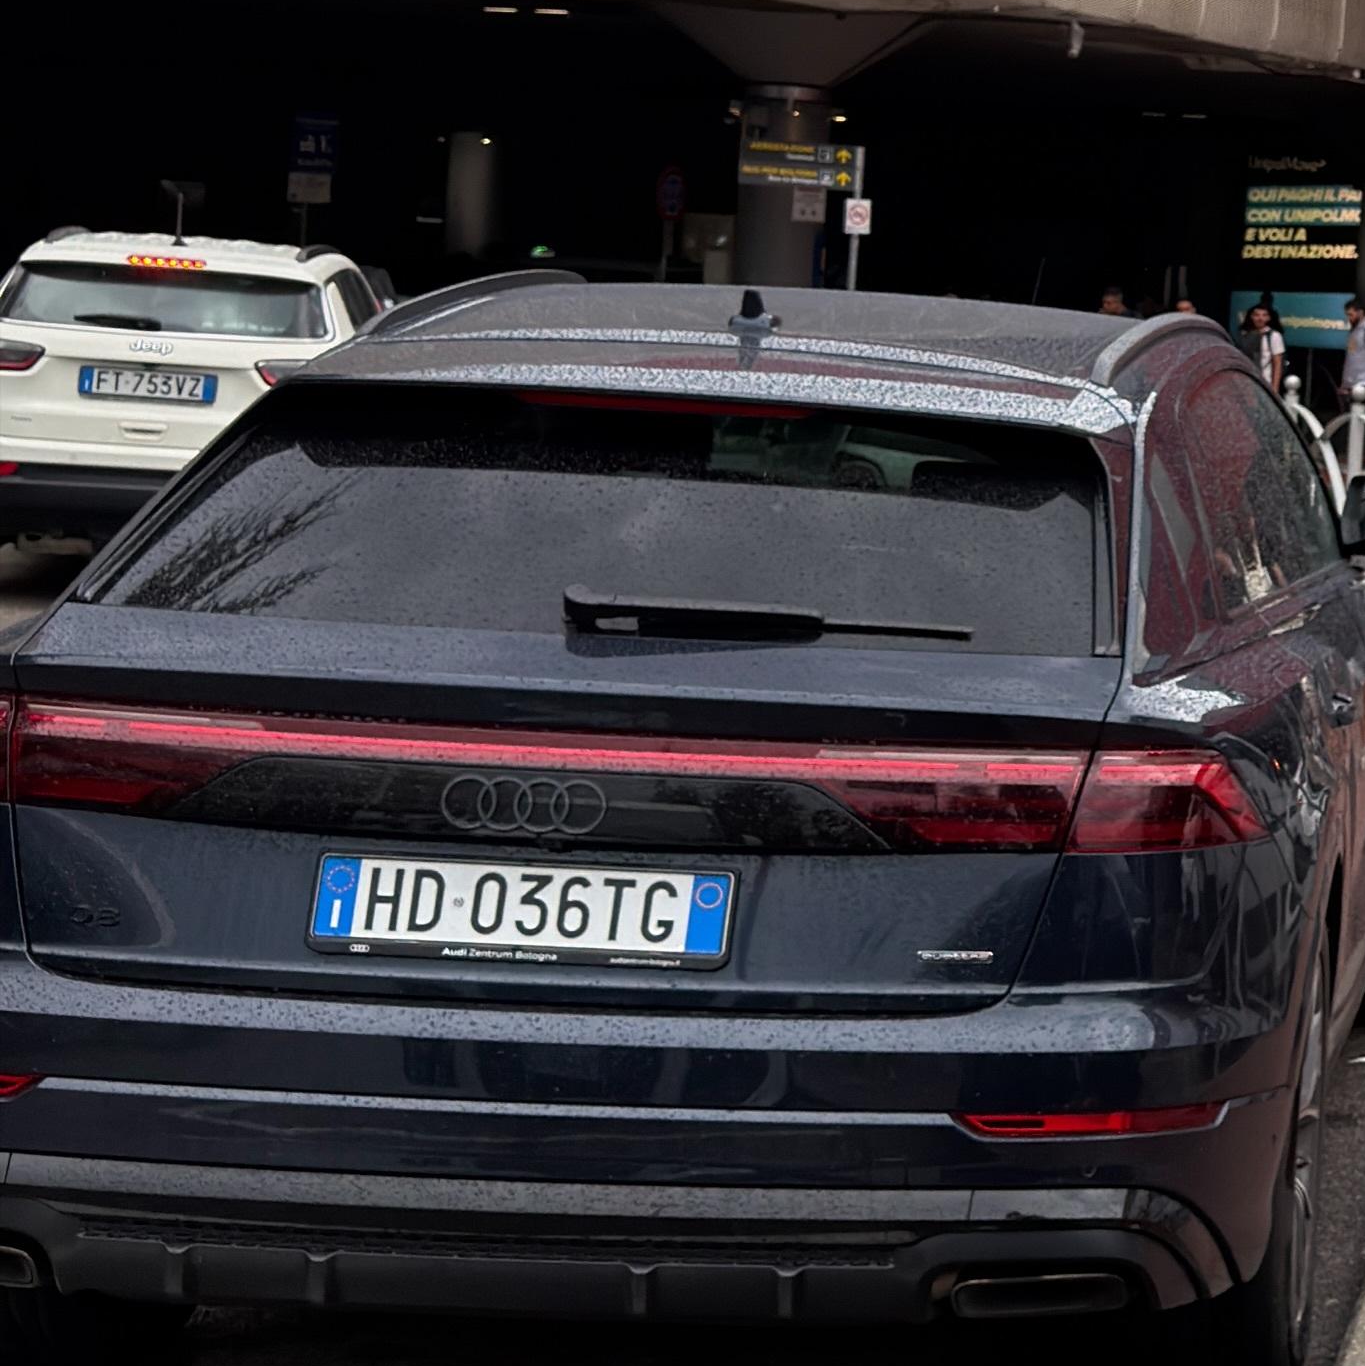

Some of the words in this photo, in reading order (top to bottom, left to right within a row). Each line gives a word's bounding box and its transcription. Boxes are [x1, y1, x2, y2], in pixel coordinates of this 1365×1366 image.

[1247, 208, 1282, 223] CON
[1245, 227, 1257, 242] E
[1258, 227, 1294, 242] VOLI
[1294, 227, 1308, 242] A
[1242, 243, 1360, 259] DESTINAZIONE.
[129, 338, 173, 355] Jeep
[96, 369, 123, 392] FT
[132, 372, 202, 398] 753VZ
[364, 866, 446, 932] HD
[469, 871, 679, 944] 036TG
[441, 946, 467, 957] Audi
[468, 948, 513, 959] Zentrum
[515, 950, 558, 962] Bologna
